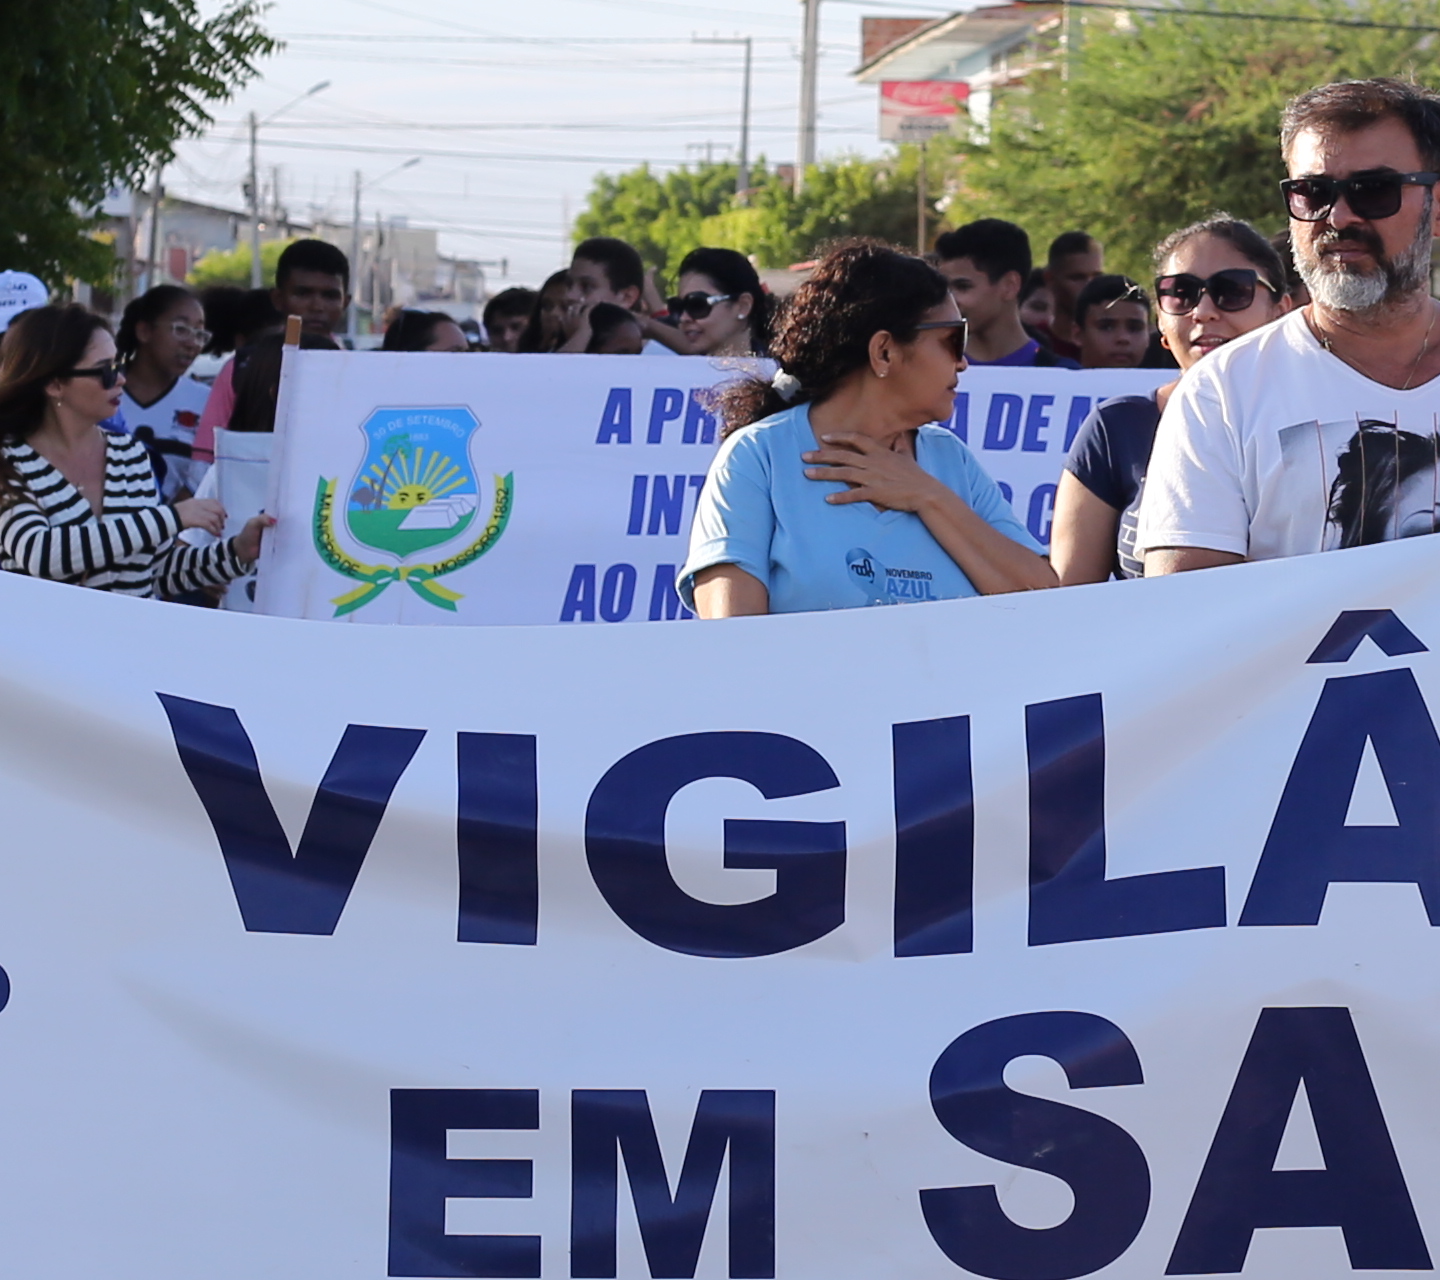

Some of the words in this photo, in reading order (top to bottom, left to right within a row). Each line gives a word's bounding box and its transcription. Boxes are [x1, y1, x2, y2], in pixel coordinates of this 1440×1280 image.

[387, 417, 404, 432] DE
[406, 414, 466, 439] SETEMBRO
[596, 387, 632, 444] A
[982, 392, 1055, 453] DE
[432, 524, 501, 577] MOSSORÓ
[494, 487, 510, 519] 1852
[339, 560, 361, 577] DE
[885, 567, 933, 581] NOVEMBRO
[887, 578, 937, 600] AZUL
[559, 563, 638, 622] AO
[386, 1087, 776, 1279] EM
